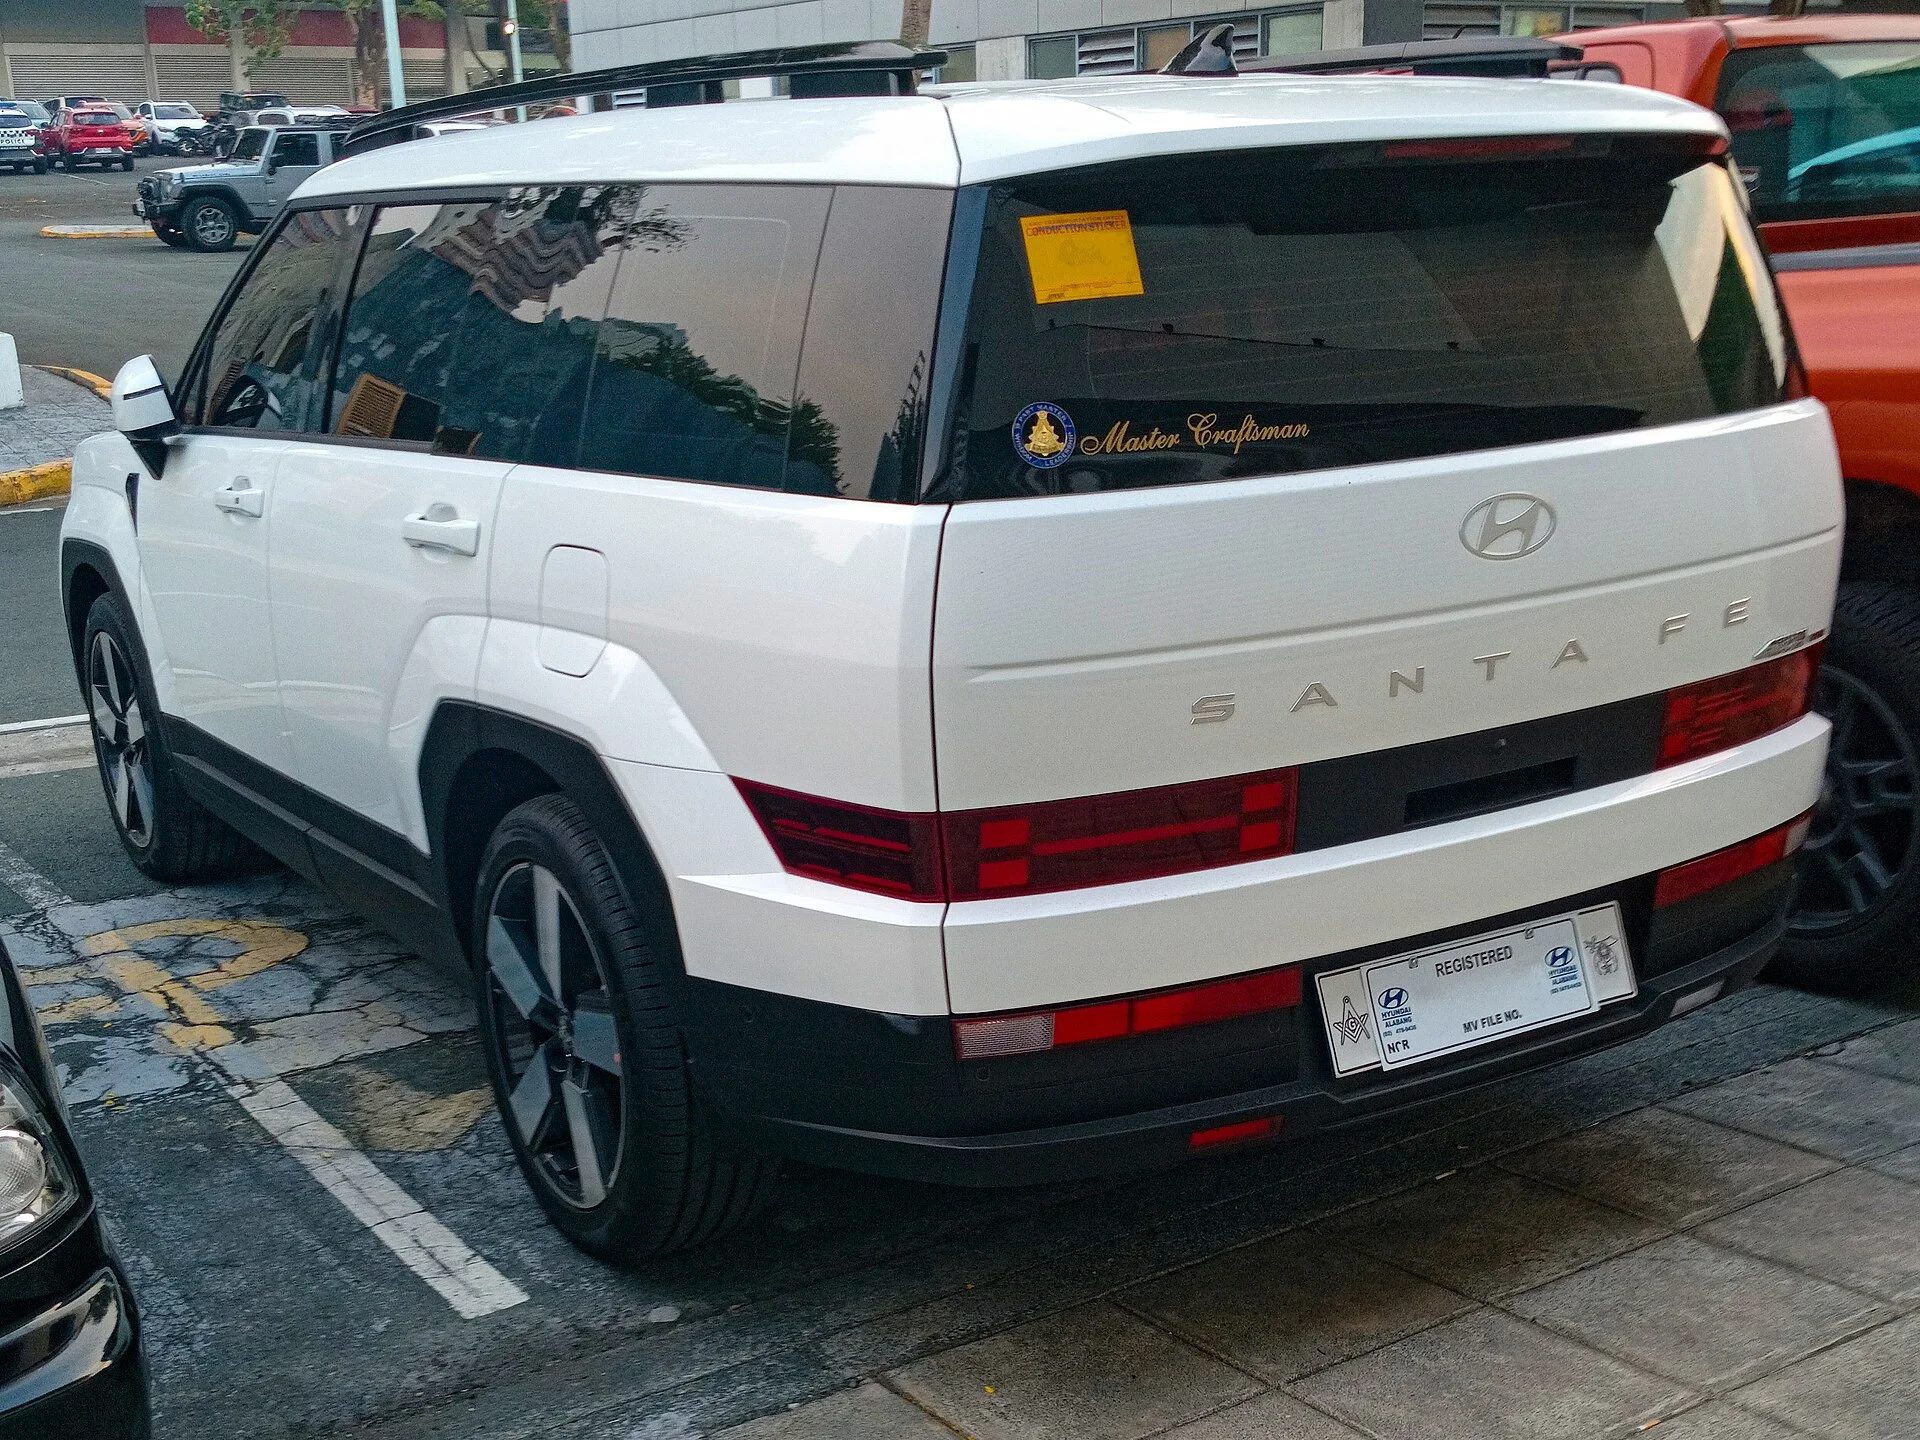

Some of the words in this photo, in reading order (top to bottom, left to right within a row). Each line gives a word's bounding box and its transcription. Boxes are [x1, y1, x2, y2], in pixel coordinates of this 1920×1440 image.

[1080, 420, 1180, 456] Master
[1187, 413, 1310, 455] Craftsman
[1190, 638, 1589, 725] SANTA
[1658, 596, 1752, 645] FE
[1434, 945, 1513, 978] REGISTERED
[1381, 1006, 1412, 1018] HYUNDAI
[1384, 1016, 1412, 1028] ALABANG
[1462, 1019, 1478, 1034] MV
[1480, 1013, 1503, 1029] FILE
[1504, 1008, 1523, 1022] NO.
[1387, 1039, 1410, 1054] NCR
